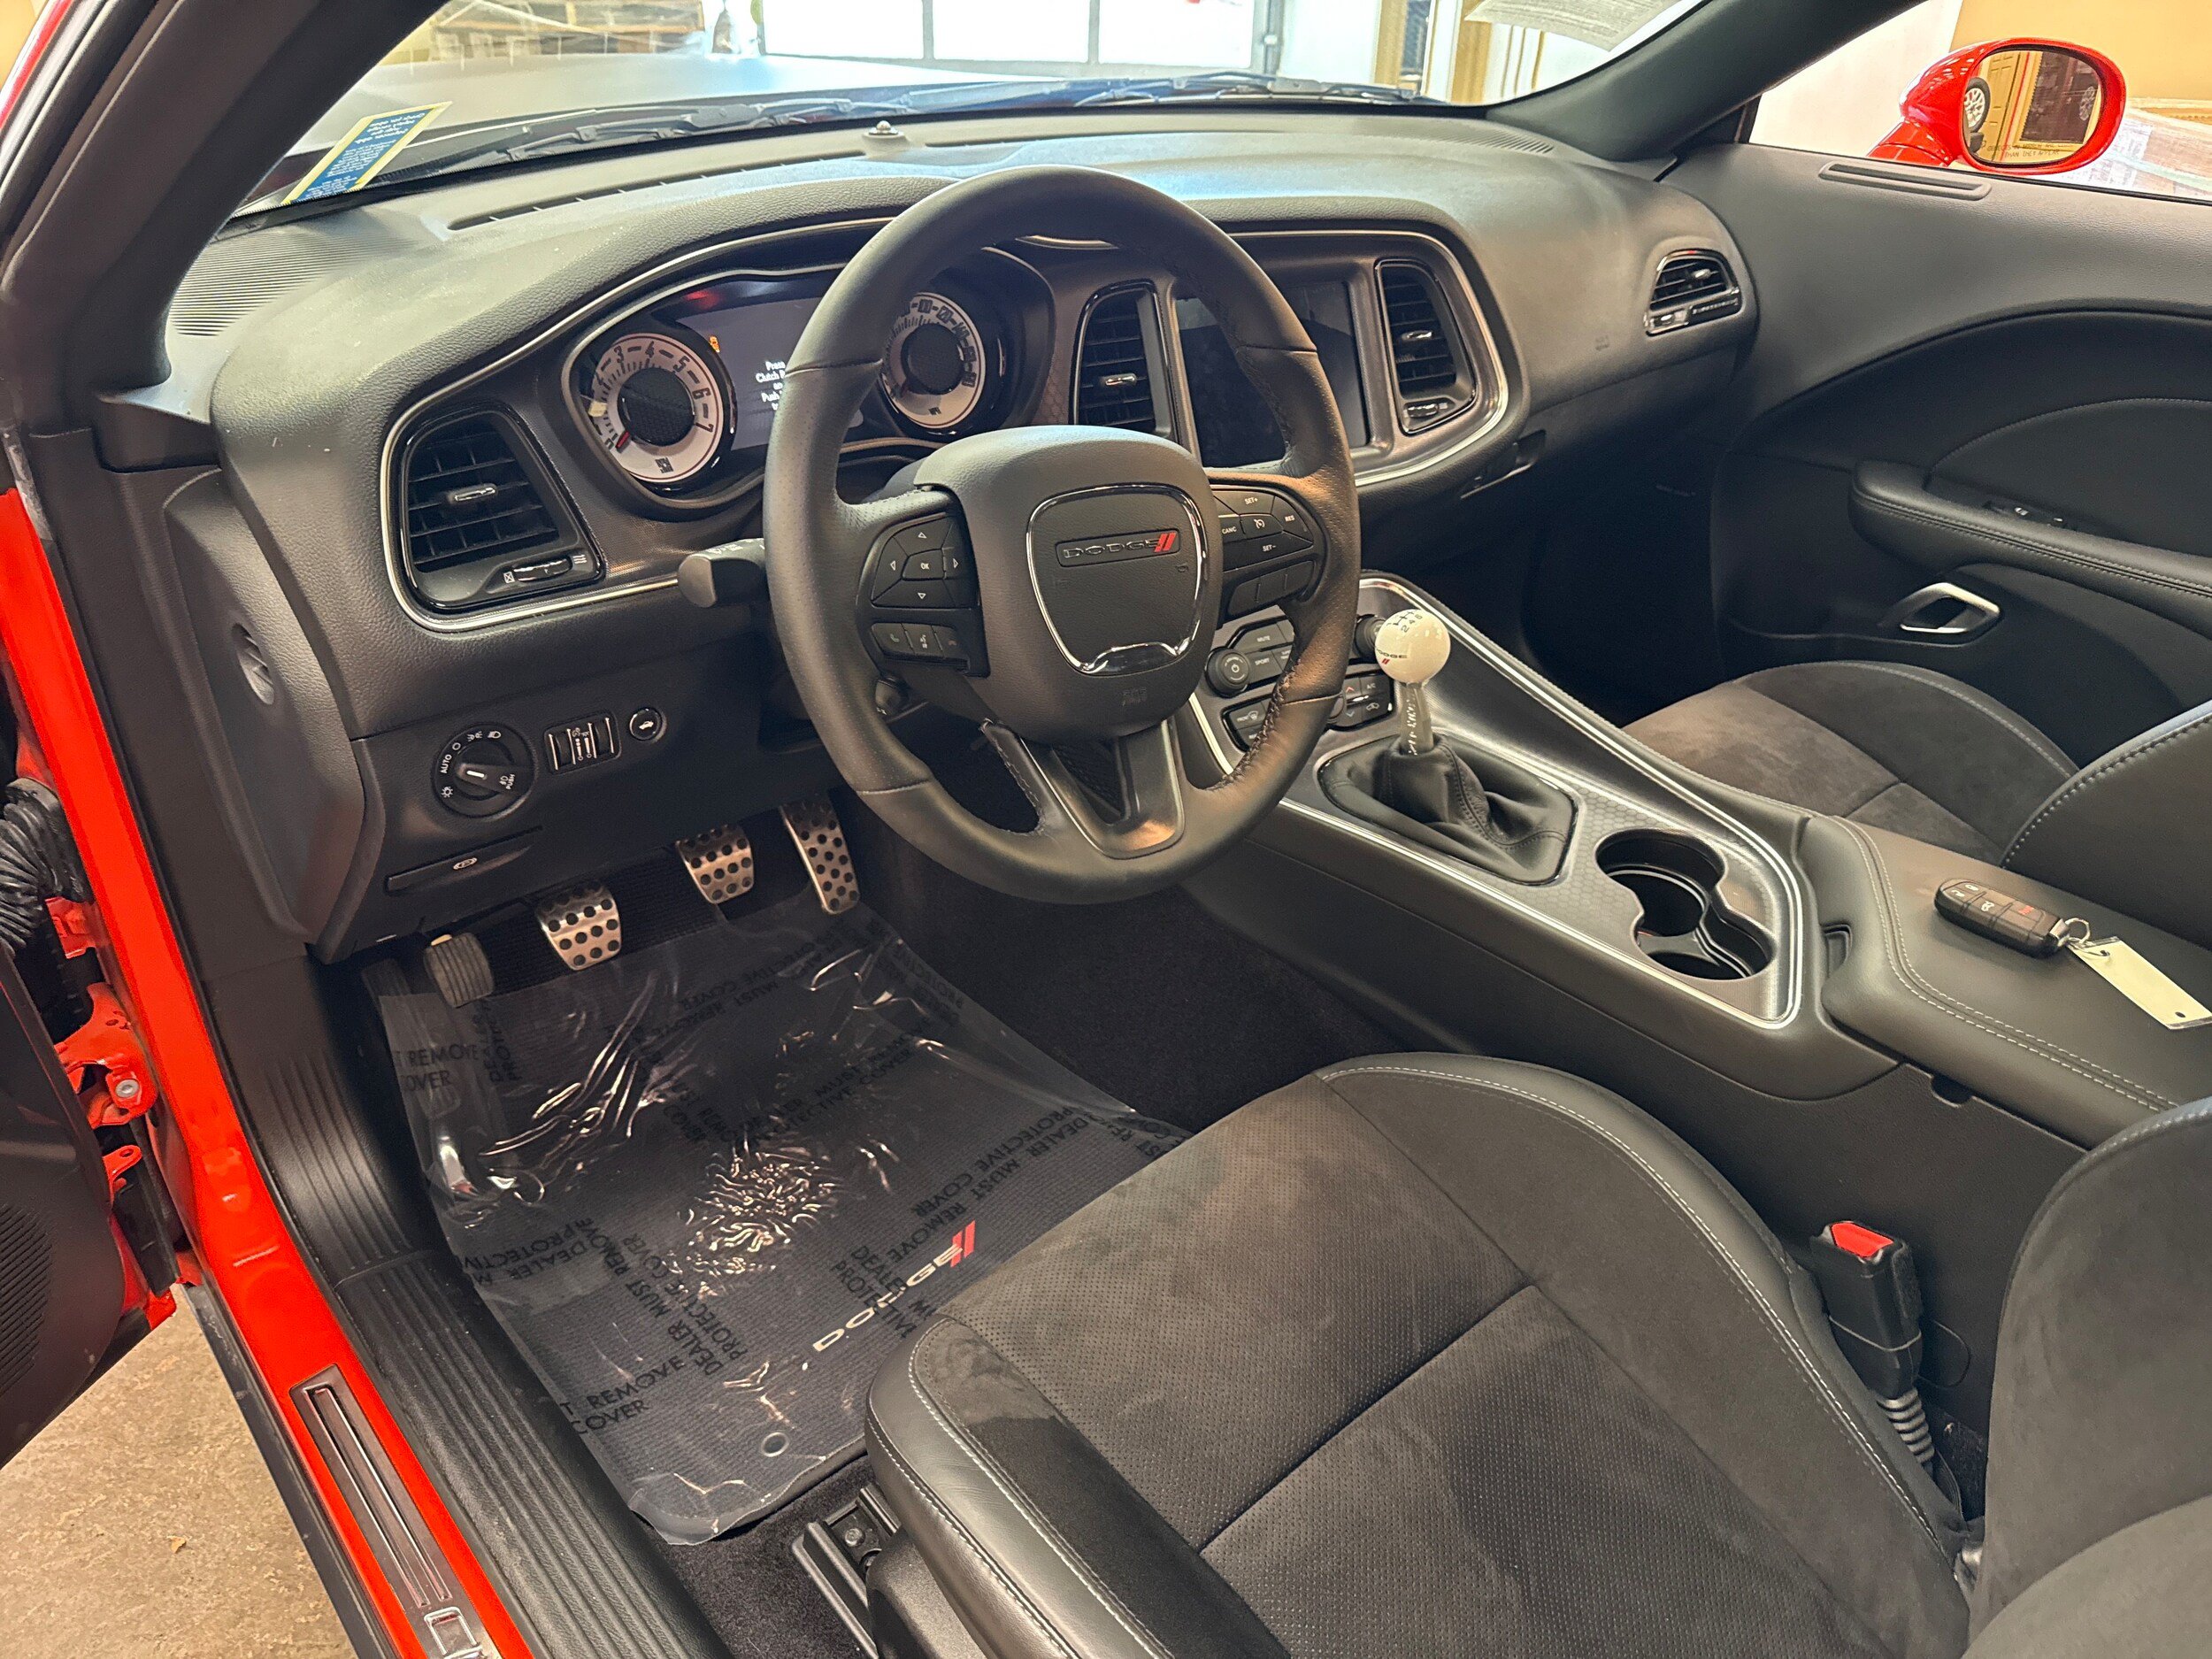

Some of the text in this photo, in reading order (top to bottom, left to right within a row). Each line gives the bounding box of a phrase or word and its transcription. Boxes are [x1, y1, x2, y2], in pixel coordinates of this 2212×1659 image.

[614, 345, 625, 364] 3
[644, 341, 655, 358] 4
[672, 356, 690, 373] 5
[692, 387, 711, 400] 6
[695, 421, 715, 433] 7
[1222, 526, 1237, 534] CANC
[1064, 538, 1162, 558] DODGE
[920, 562, 930, 571] OK
[1401, 624, 1409, 634] 2
[1255, 657, 1270, 666] SPORT
[441, 754, 452, 774] AUTO
[505, 773, 516, 790] PUSH
[733, 980, 779, 1007] MUST
[814, 1066, 861, 1097] MUST
[912, 1106, 1074, 1218] PROTECTIVE COVER
[887, 1117, 1089, 1263] DEALER MUST REMOVE
[463, 1223, 576, 1271] PROTECTIV
[507, 1241, 588, 1280] DEALER
[625, 1280, 672, 1319] MUST
[812, 1242, 964, 1353] DODGE
[667, 1318, 725, 1376] DEALER
[586, 1355, 686, 1409] REMOVE
